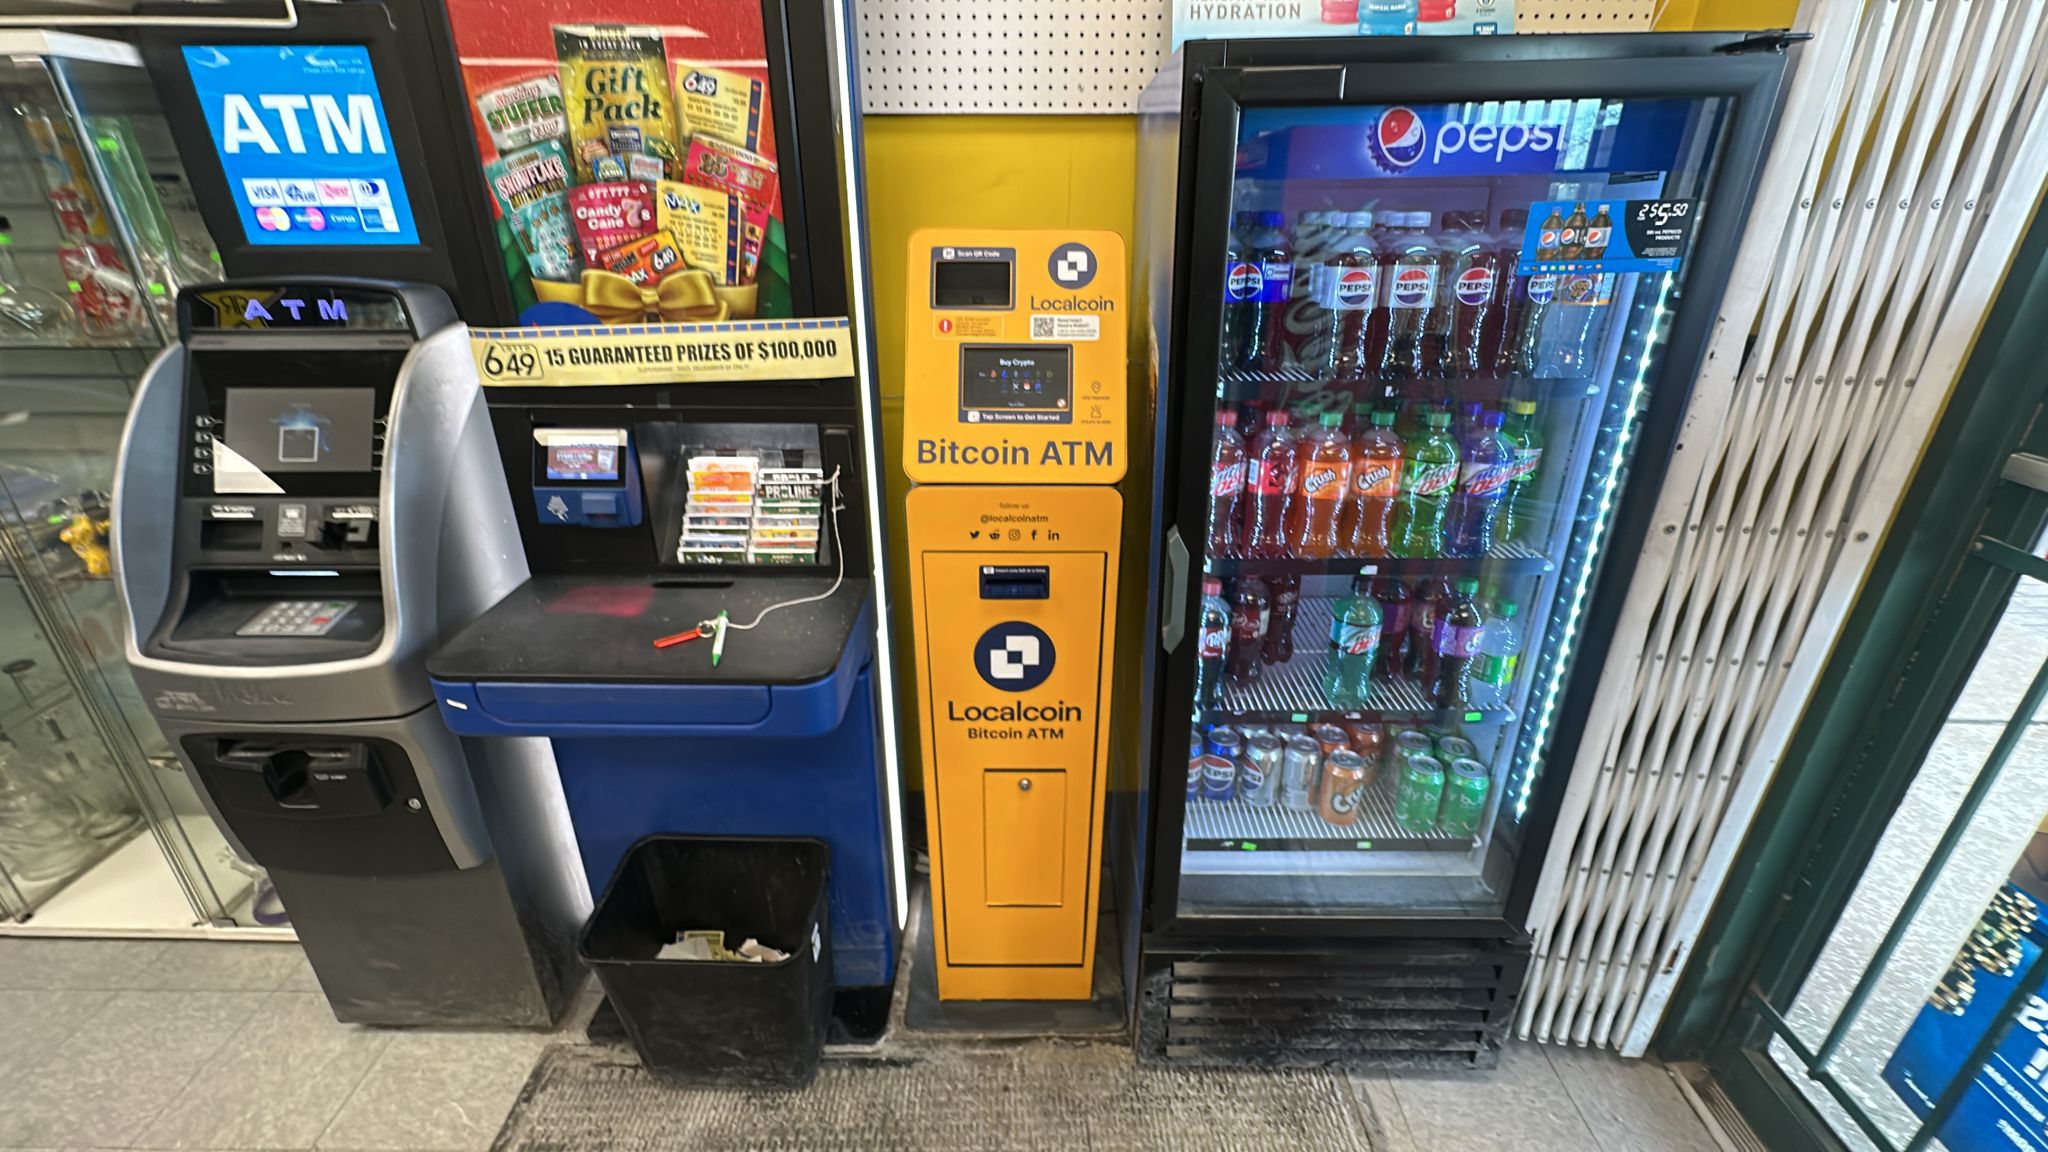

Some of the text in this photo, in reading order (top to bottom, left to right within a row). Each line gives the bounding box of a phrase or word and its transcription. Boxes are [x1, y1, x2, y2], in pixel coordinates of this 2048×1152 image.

[1190, 4, 1301, 20] HYDRATION
[584, 63, 645, 96] Gift
[683, 72, 717, 96] 649
[486, 94, 564, 133] STUFFER
[583, 93, 662, 124] Pack
[224, 94, 387, 154] ATM
[495, 153, 568, 201] SNOWFLAKE
[252, 185, 280, 199] VISA
[576, 203, 621, 220] Candy
[588, 217, 625, 230] Cane
[1339, 284, 1371, 293] PEPSI
[1396, 282, 1429, 291] PEPSI
[1458, 282, 1491, 291] PEPSI
[244, 299, 348, 320] ATM
[1030, 295, 1115, 312] Localcoin
[485, 339, 837, 375] 649 15 GUARANTEED PRIZES OF $100,000
[999, 358, 1036, 369] Buy Crypto
[917, 438, 1113, 466] Bitcoin ATM
[1304, 468, 1336, 494] Crush
[1357, 465, 1391, 490] Crush
[766, 484, 813, 499] PROLINE
[980, 514, 1049, 524] @localcoinatm
[948, 701, 1082, 722] Localcoin
[967, 727, 1064, 740] Bitcoin ATM
